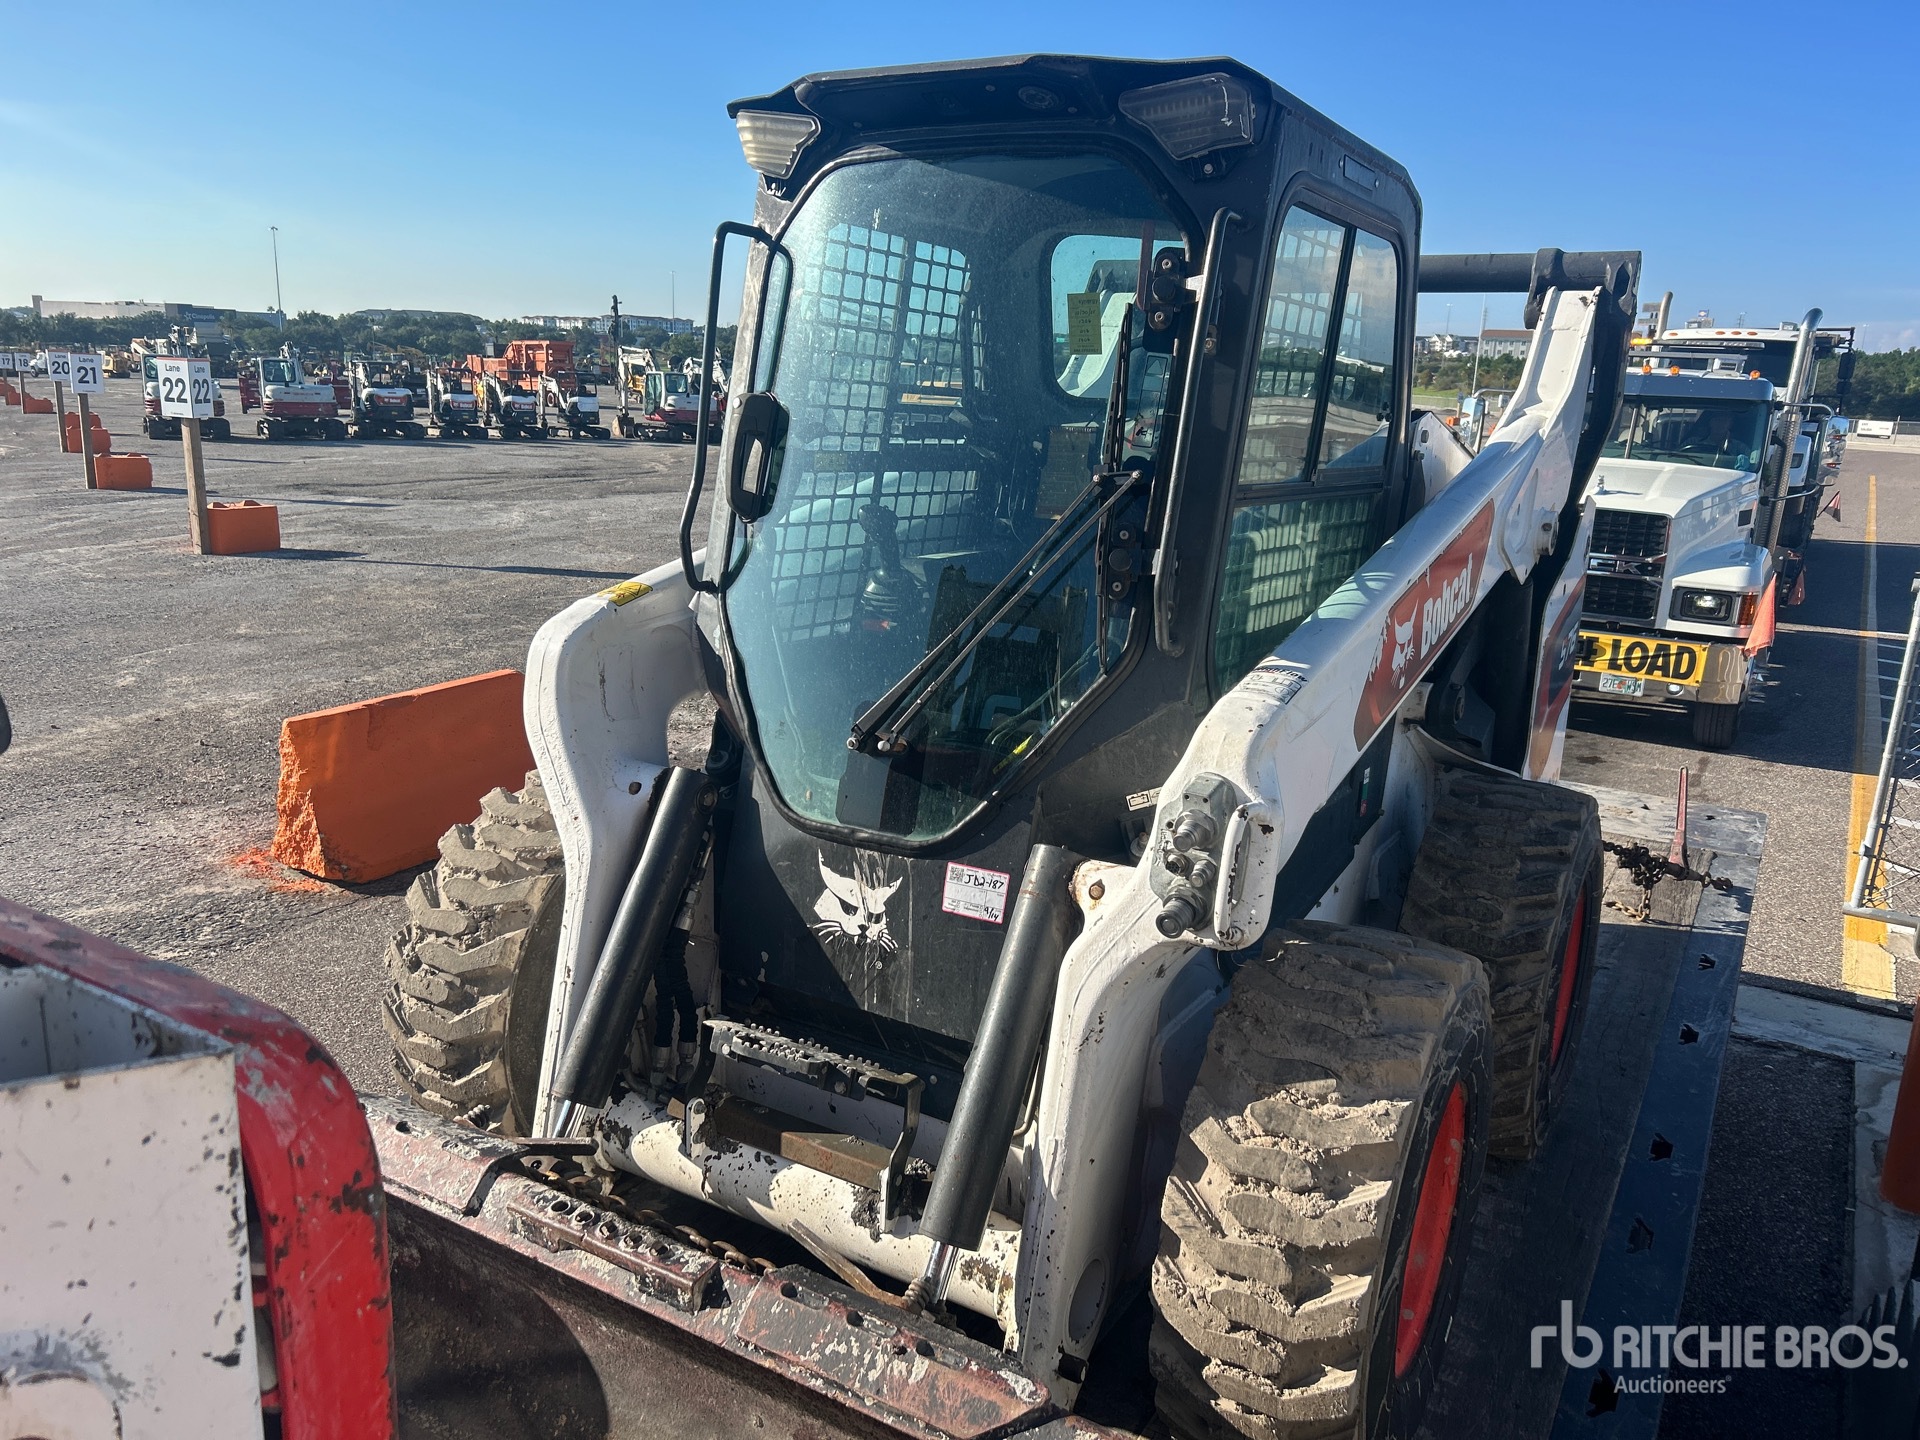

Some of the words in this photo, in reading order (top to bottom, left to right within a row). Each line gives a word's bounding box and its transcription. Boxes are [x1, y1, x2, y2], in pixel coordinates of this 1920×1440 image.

[2, 358, 10, 366] 17
[18, 358, 29, 367] 18
[51, 361, 70, 375] 20
[165, 363, 181, 372] Lane
[194, 365, 206, 373] Lane
[76, 366, 97, 385] 21
[162, 376, 188, 404] 22
[192, 378, 211, 404] 22
[1420, 552, 1472, 660] Bobcat
[1607, 638, 1697, 681] LOAD
